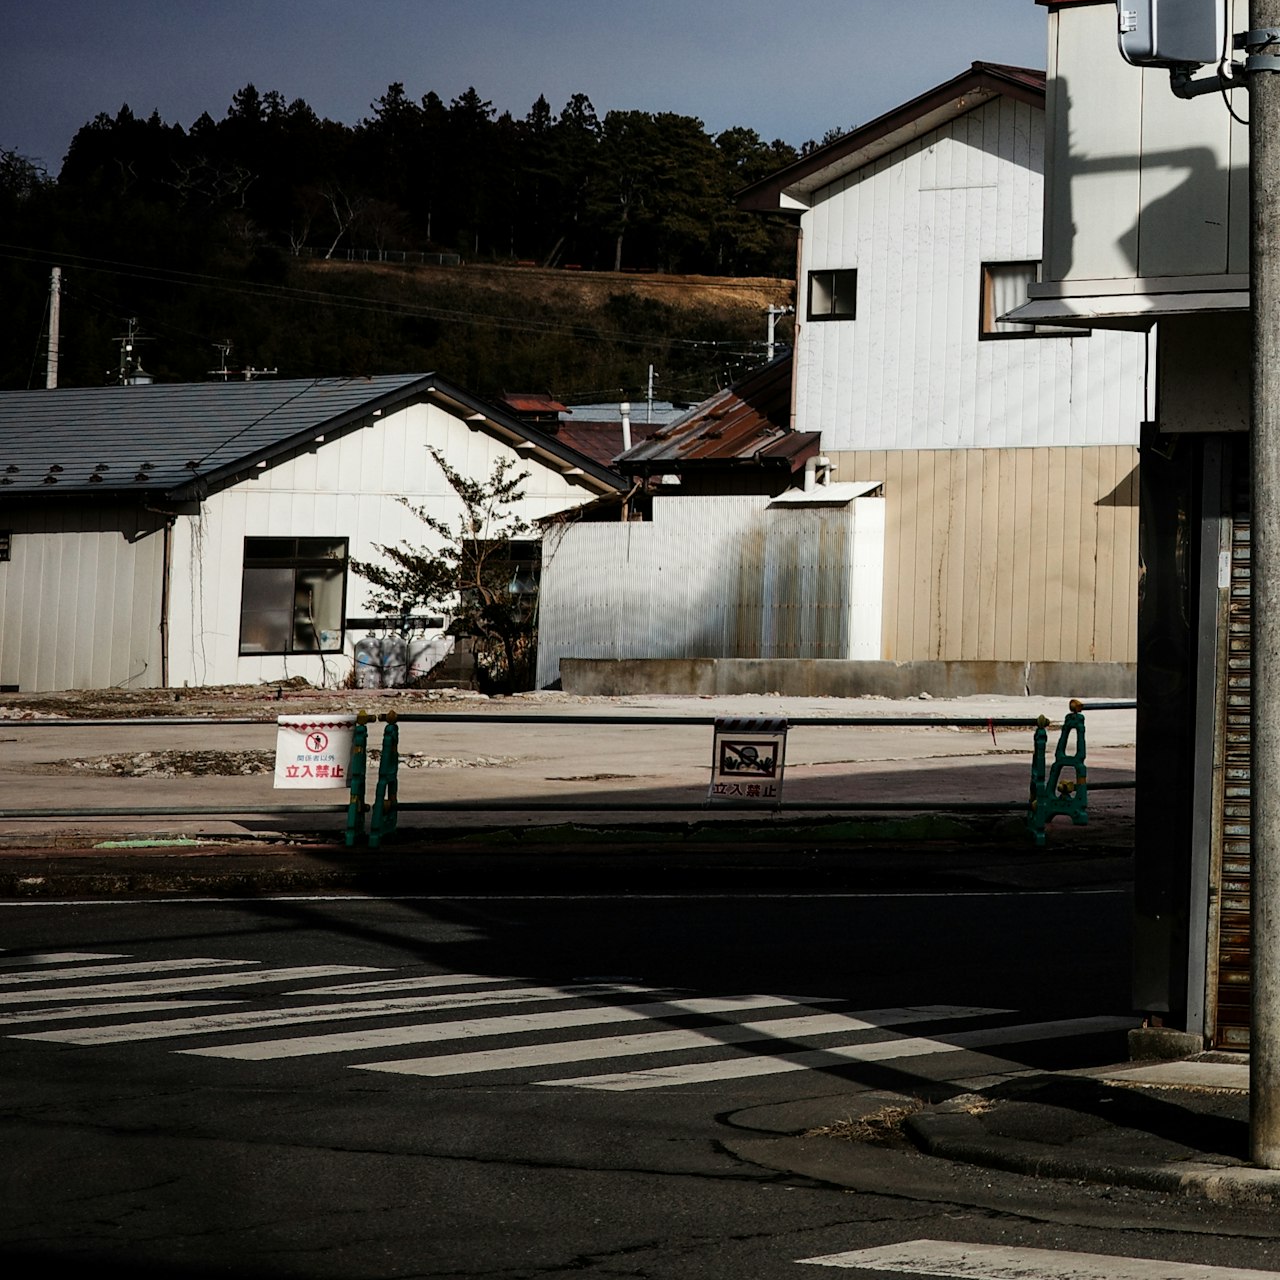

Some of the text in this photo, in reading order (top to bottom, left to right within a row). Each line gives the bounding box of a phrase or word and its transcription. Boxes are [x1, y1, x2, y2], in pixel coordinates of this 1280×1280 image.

[285, 764, 344, 778] 立入禁止
[713, 783, 776, 797] 立入禁止
